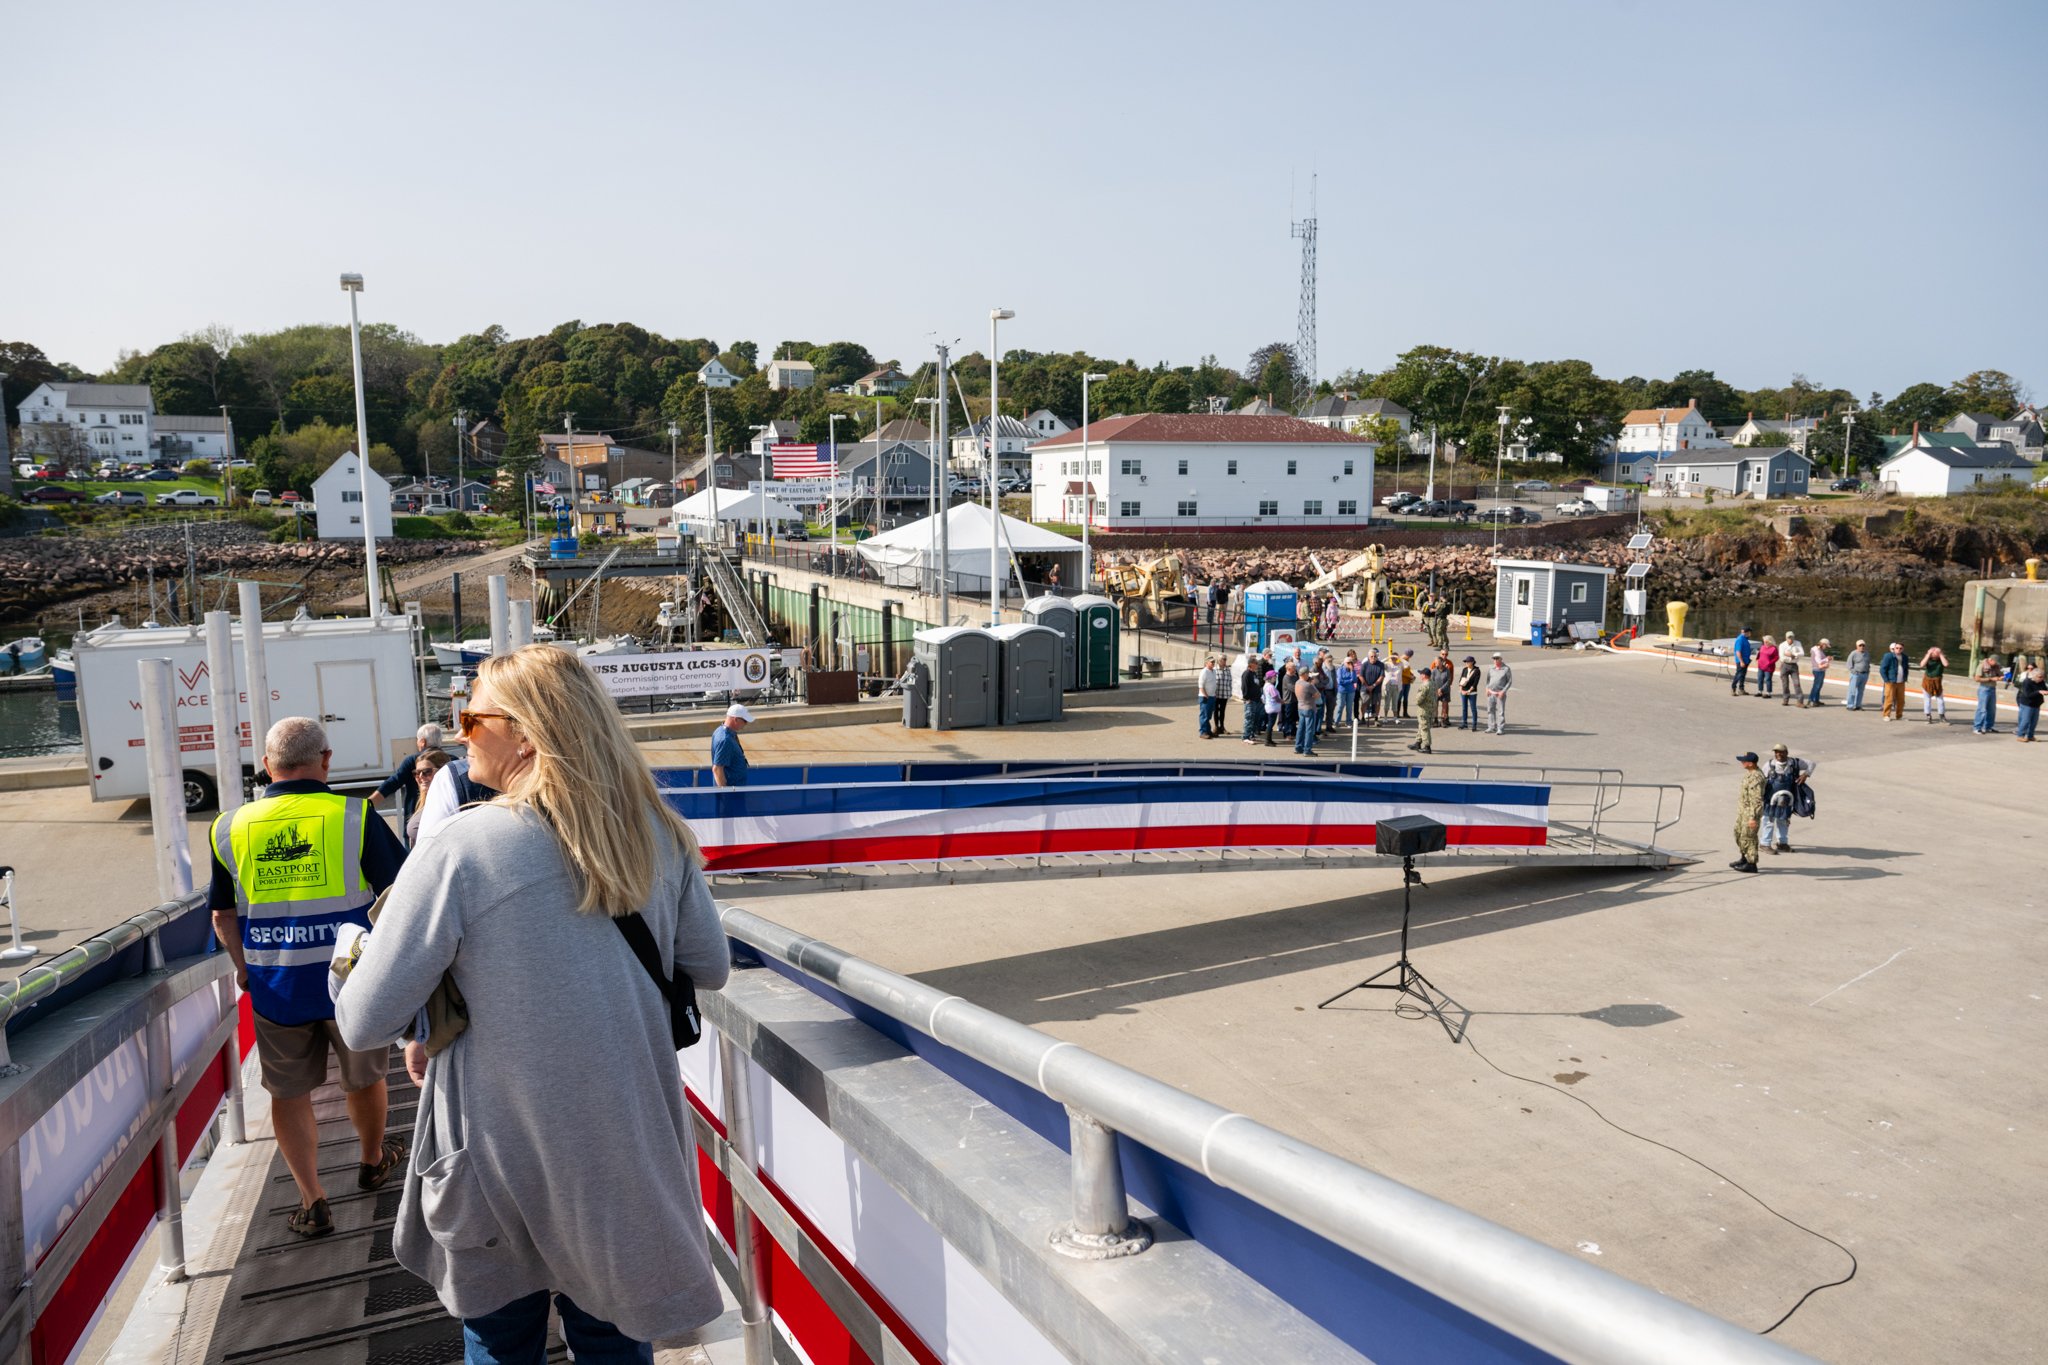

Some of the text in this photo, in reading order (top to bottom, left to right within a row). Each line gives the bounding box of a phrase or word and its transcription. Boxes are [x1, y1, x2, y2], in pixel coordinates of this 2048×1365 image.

[592, 664, 618, 674] USS
[621, 661, 684, 673] AUGUSTA
[687, 658, 742, 671] (LCS-34)
[612, 672, 722, 684] Commissioning Ceremony
[665, 682, 702, 690] September
[704, 681, 713, 689] 30,
[129, 694, 208, 711] WACE
[257, 862, 321, 877] EASTPORT
[259, 874, 321, 886] PORT AUTHORITY
[249, 921, 342, 944] SECURITY
